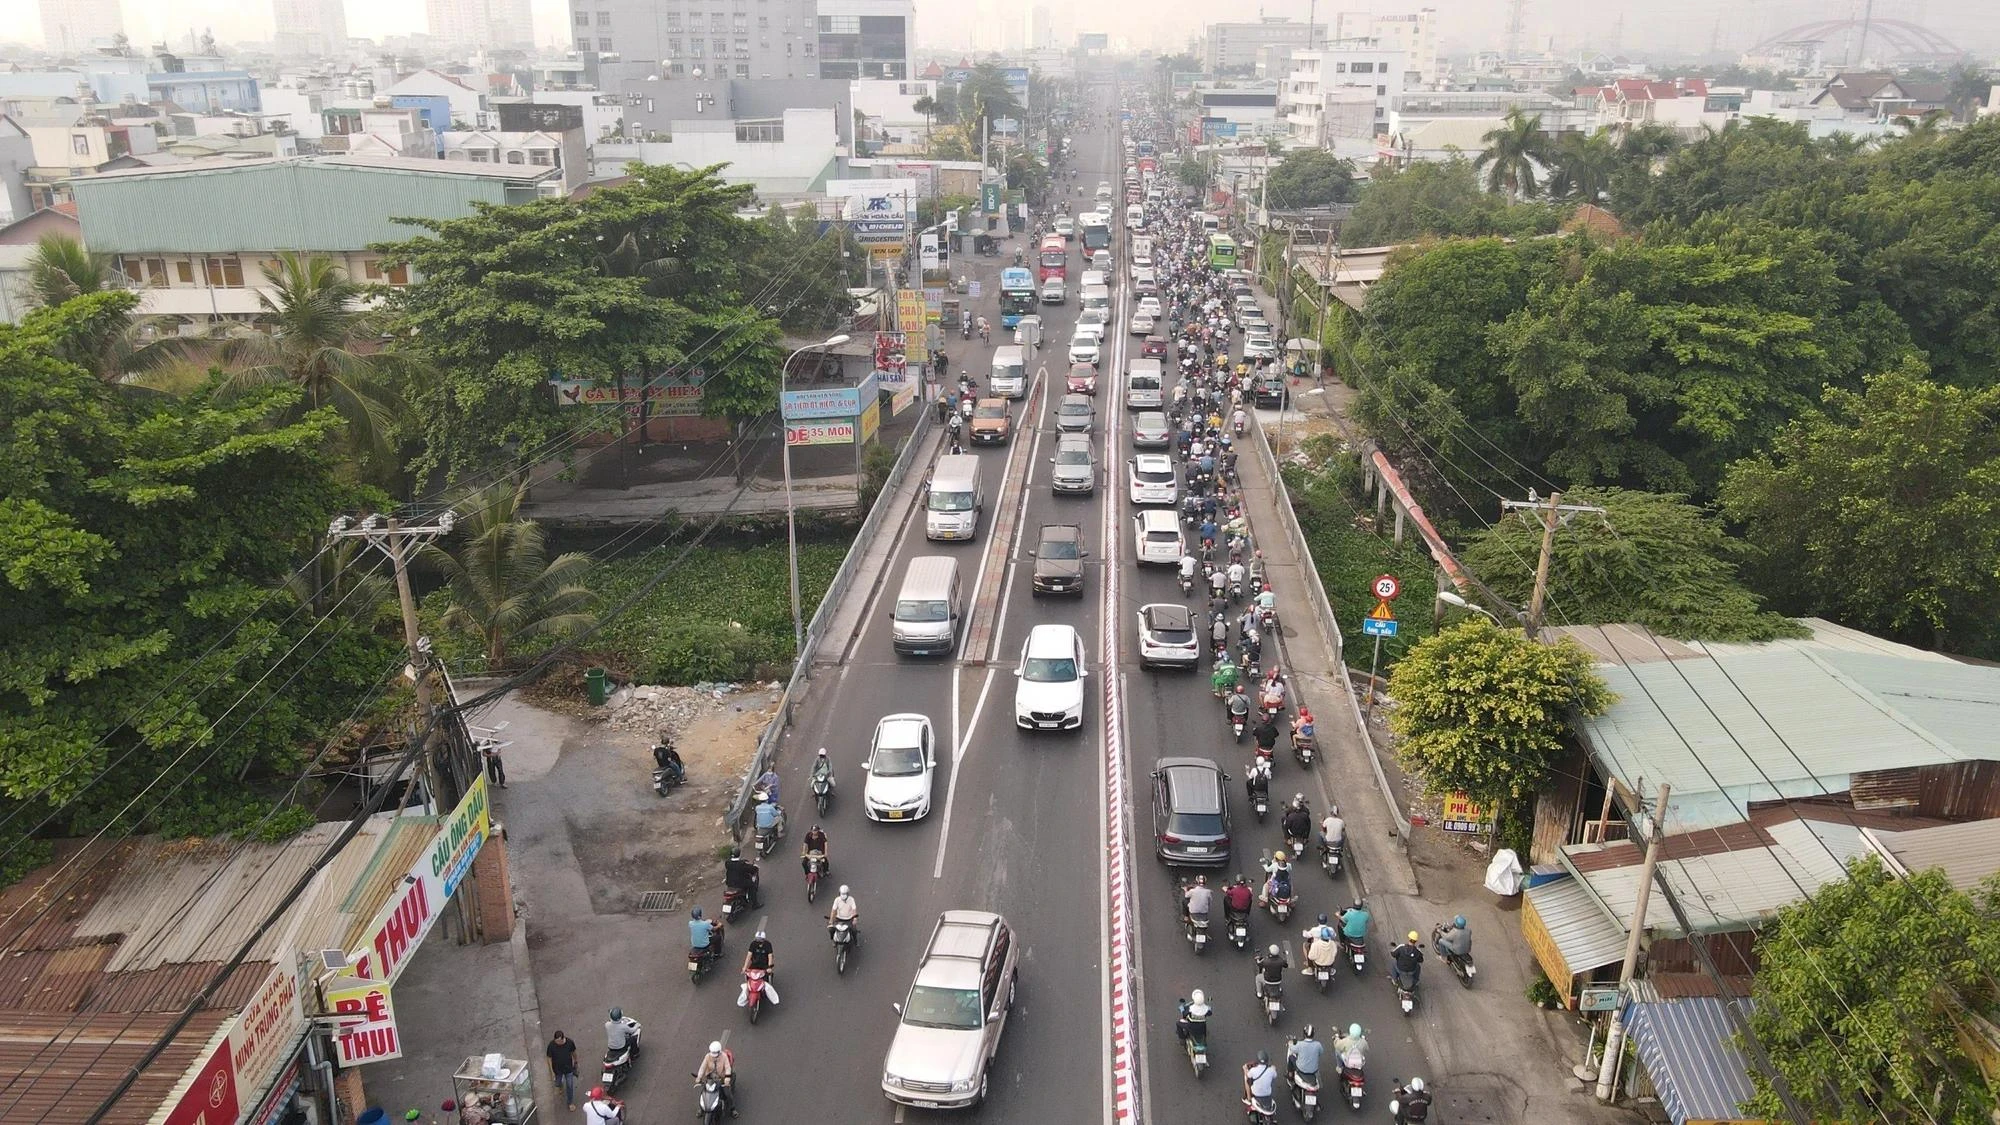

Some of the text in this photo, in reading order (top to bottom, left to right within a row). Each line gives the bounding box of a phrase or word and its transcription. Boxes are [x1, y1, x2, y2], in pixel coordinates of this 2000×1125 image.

[811, 427, 824, 436] 35
[432, 837, 450, 877] CẦU
[450, 813, 468, 851] ÔNG
[374, 876, 430, 980] THUI
[262, 970, 284, 1005] HÀNG
[235, 1032, 255, 1074] MINH
[254, 1000, 280, 1044] TRUNG
[278, 973, 297, 1014] PHÁT
[335, 991, 390, 1028] BÊ
[338, 1027, 397, 1061] THUI
